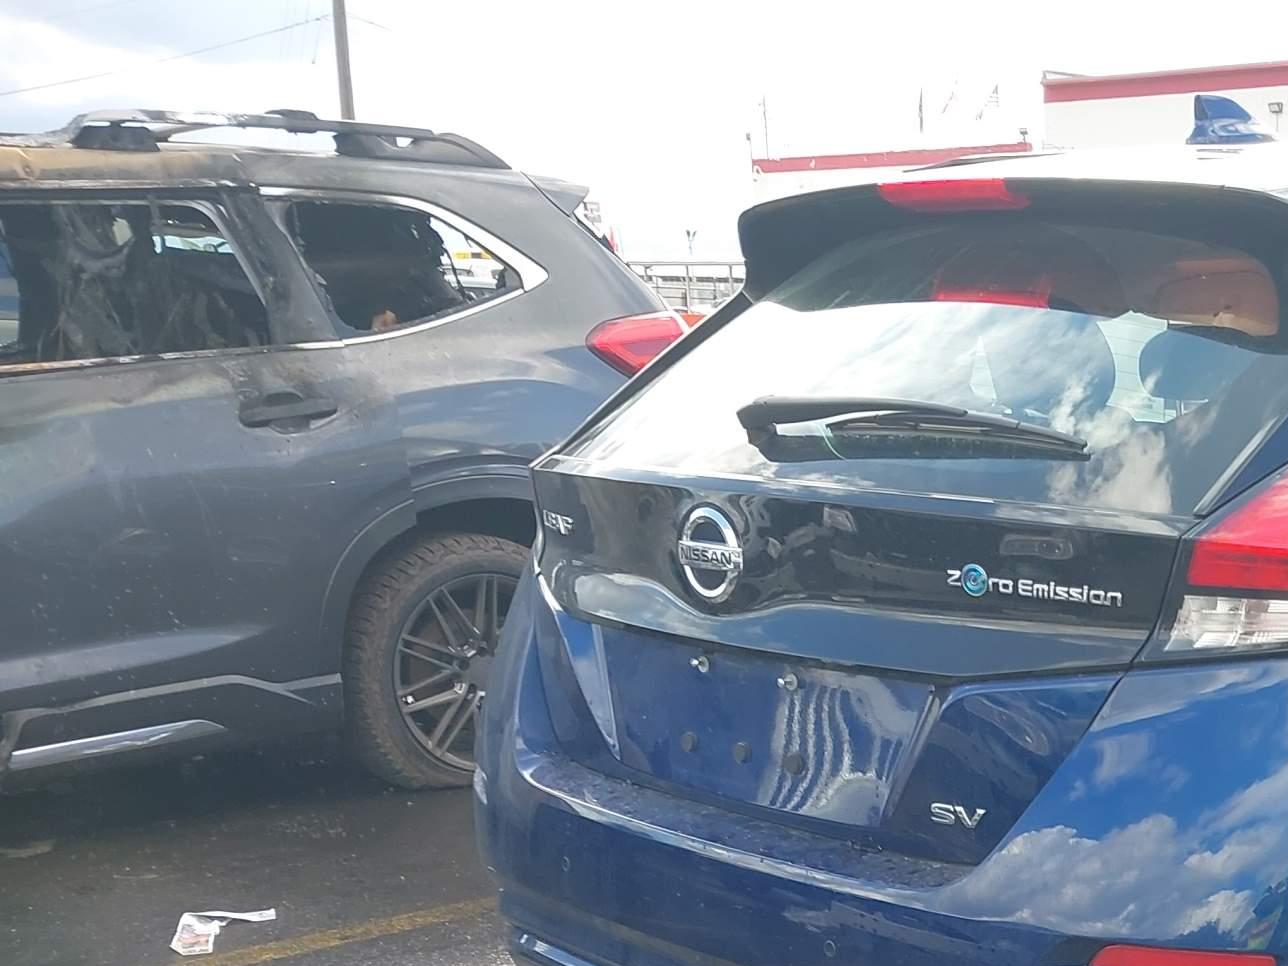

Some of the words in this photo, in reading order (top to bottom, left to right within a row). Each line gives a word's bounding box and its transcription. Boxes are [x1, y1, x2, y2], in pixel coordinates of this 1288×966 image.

[680, 545, 734, 569] NISSAN
[1018, 579, 1123, 607] Emission
[930, 802, 987, 829] SV
